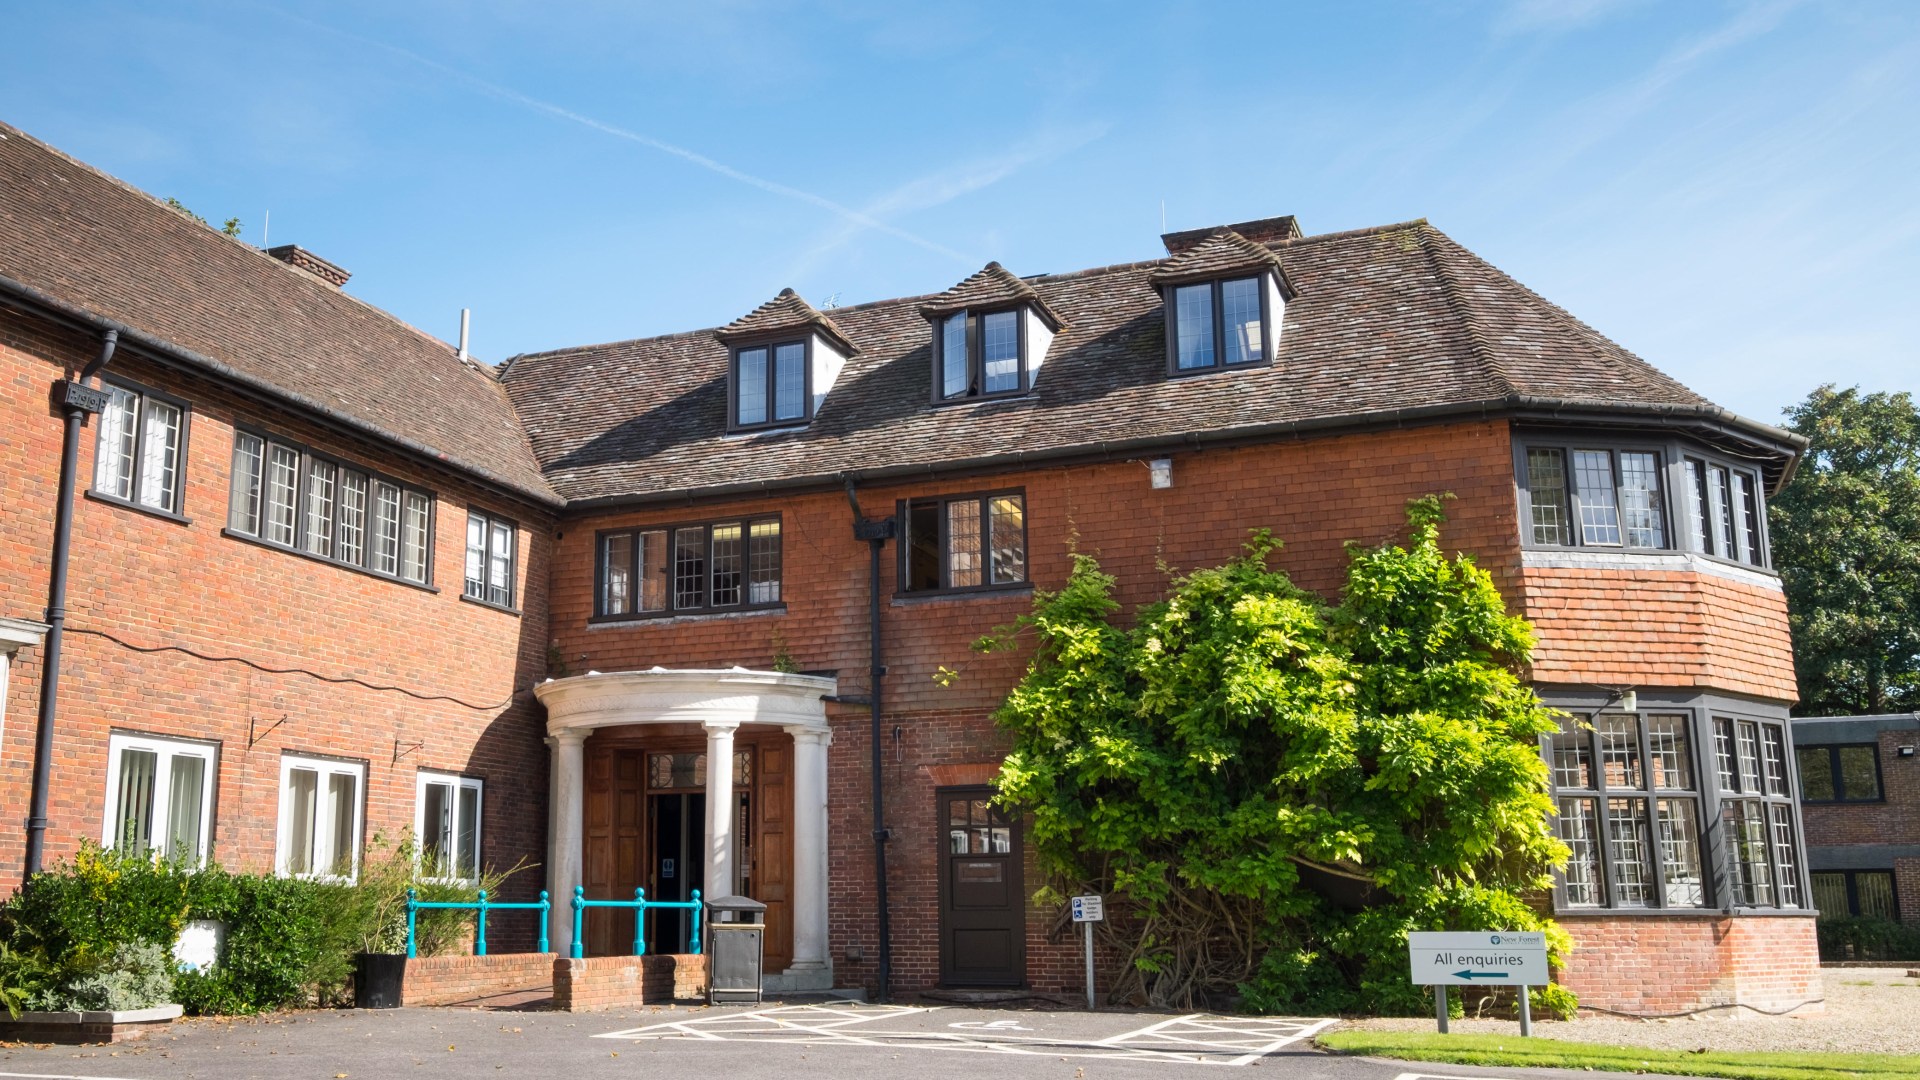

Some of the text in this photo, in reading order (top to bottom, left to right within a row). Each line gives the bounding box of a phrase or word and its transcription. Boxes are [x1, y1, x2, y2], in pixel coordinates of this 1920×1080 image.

[1518, 935, 1540, 943] Forest
[1434, 953, 1524, 968] All enquiries
